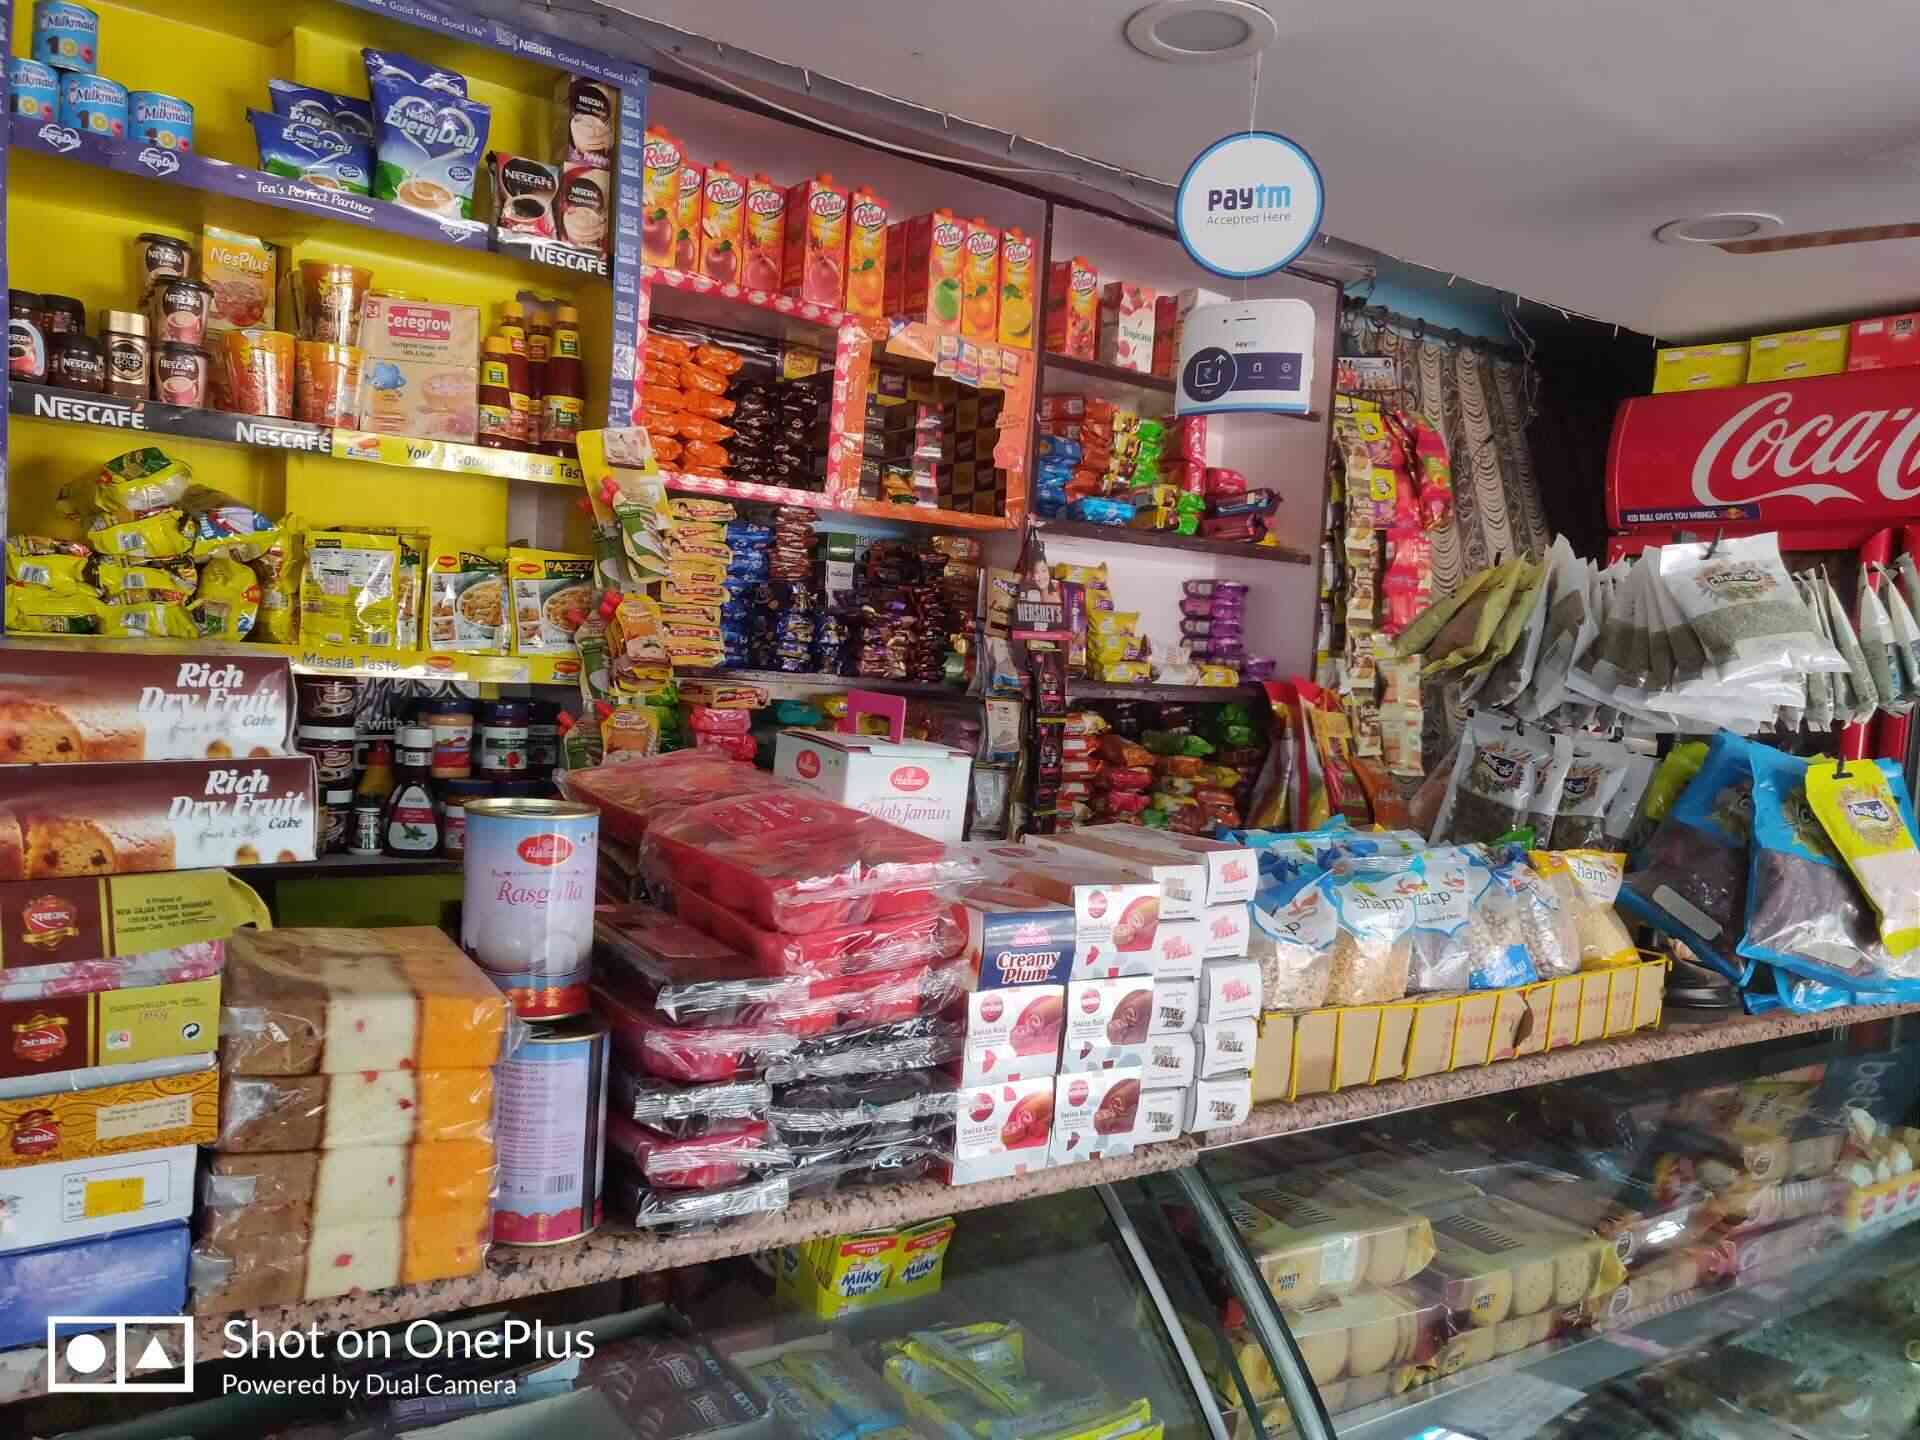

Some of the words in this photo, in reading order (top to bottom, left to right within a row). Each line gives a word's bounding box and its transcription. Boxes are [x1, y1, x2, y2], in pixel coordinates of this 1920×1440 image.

[144, 107, 192, 124] Milkmaid
[384, 106, 478, 153] EveryDay
[646, 147, 677, 164] Real
[256, 181, 285, 195] Tea's
[288, 184, 329, 202] Perfect
[332, 193, 375, 215] Partner
[710, 183, 742, 199] Real
[1207, 183, 1291, 211] paytm
[752, 195, 783, 211] Real
[812, 196, 845, 212] Real
[855, 207, 887, 224] Real
[1207, 214, 1259, 226] Accepted
[1263, 212, 1291, 223] Here
[935, 228, 963, 244] Real
[210, 247, 270, 272] NesPlus
[387, 312, 453, 333] Ceregrow
[1674, 511, 1688, 520] YOU
[1017, 603, 1063, 624] HERSHEY'S
[303, 652, 354, 669] Masala
[360, 655, 400, 672] Taste
[176, 662, 245, 688] Rich
[138, 687, 200, 713] Dry
[206, 687, 282, 713] Fruit
[242, 713, 277, 728] Cake
[205, 769, 270, 795] Rich
[168, 796, 227, 820] Dry
[232, 791, 305, 818] Fruit
[902, 803, 951, 824] Jamun
[268, 815, 303, 831] Cake
[496, 880, 583, 909] Rasglla
[996, 951, 1060, 970] Creamy
[1002, 968, 1048, 984] Plum
[902, 1259, 937, 1278] Milky
[841, 1270, 882, 1287] Milky
